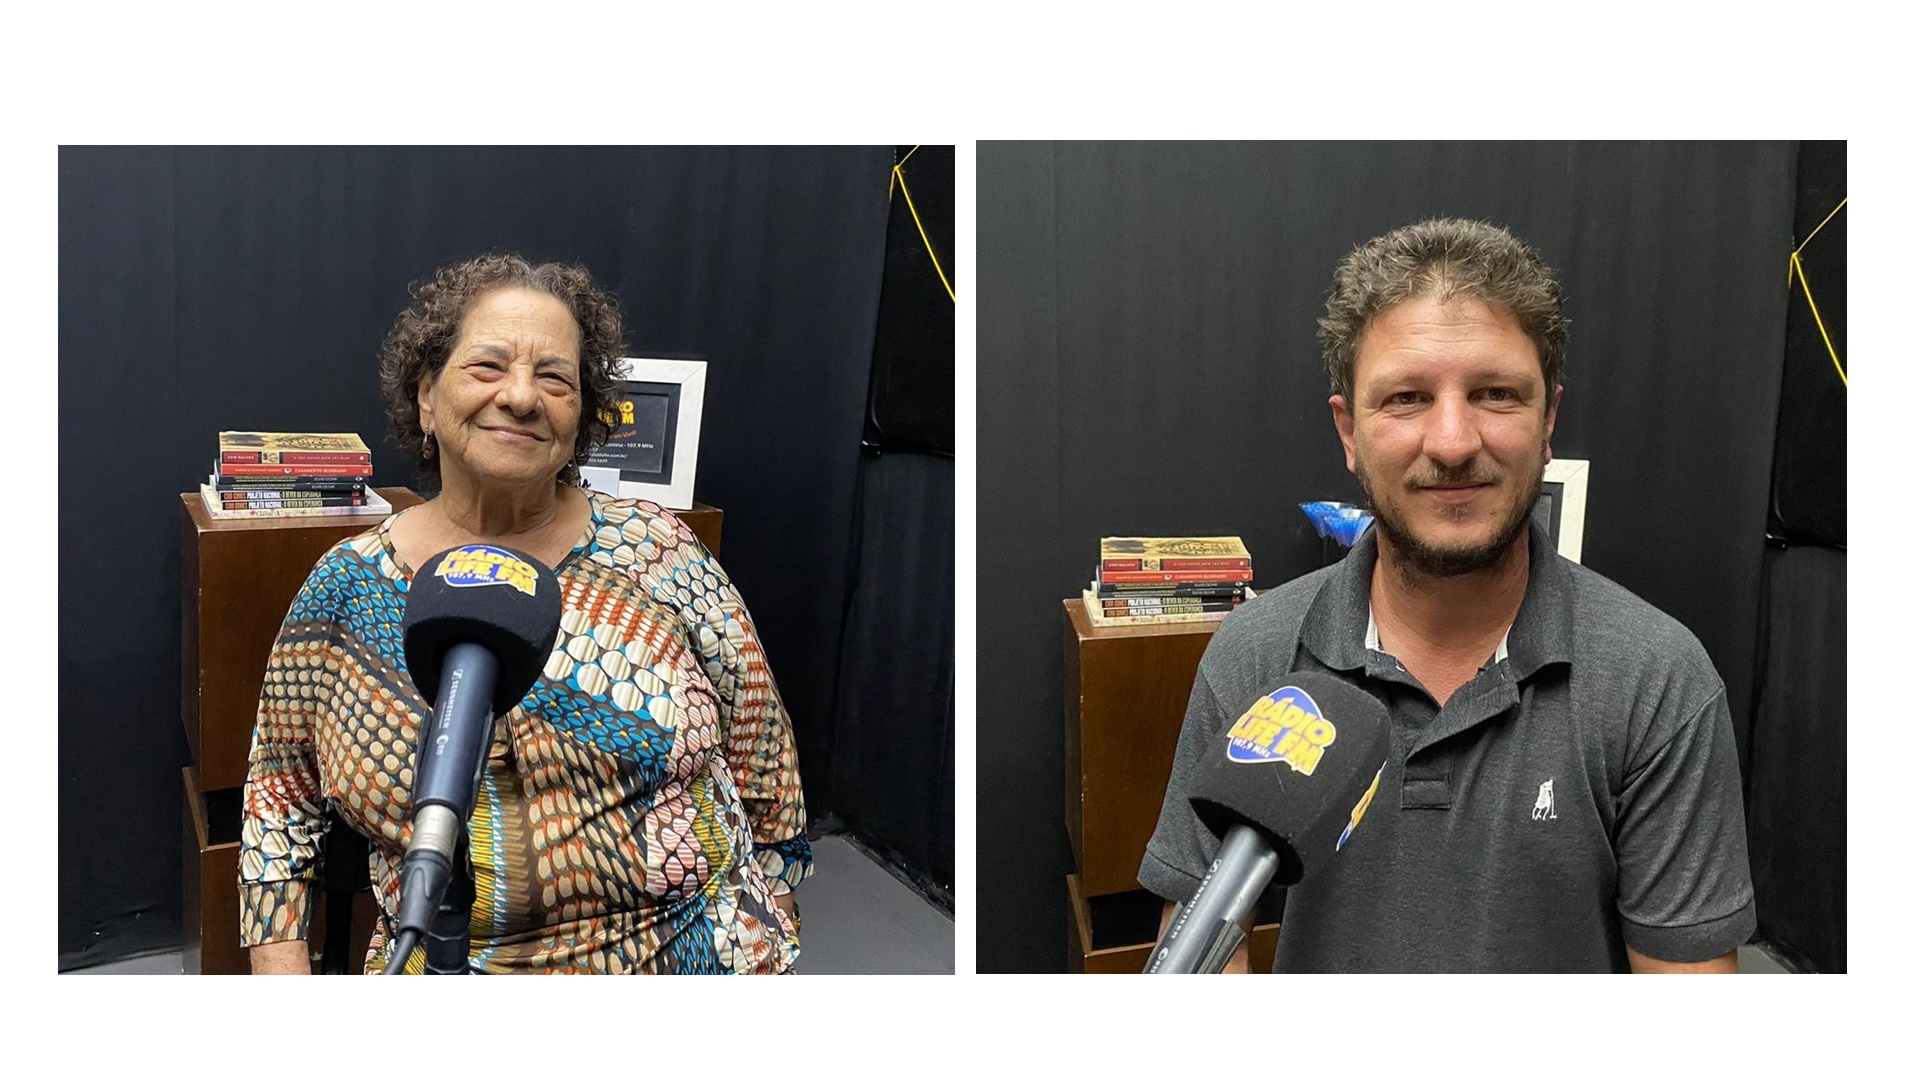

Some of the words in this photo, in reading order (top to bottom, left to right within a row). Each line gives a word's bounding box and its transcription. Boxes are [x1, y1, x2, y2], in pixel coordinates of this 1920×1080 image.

[248, 501, 265, 509] PROJETO
[437, 559, 494, 576] LIFE
[495, 565, 535, 594] FM
[444, 550, 537, 578] RÁDIO
[474, 574, 495, 582] MHz
[442, 680, 460, 729] SENNHEISER
[1252, 696, 1334, 747] RÁDIO
[1229, 713, 1283, 748] LIFE
[1273, 730, 1322, 774] FM
[1233, 738, 1254, 750] 107,9
[1252, 744, 1271, 758] MHz
